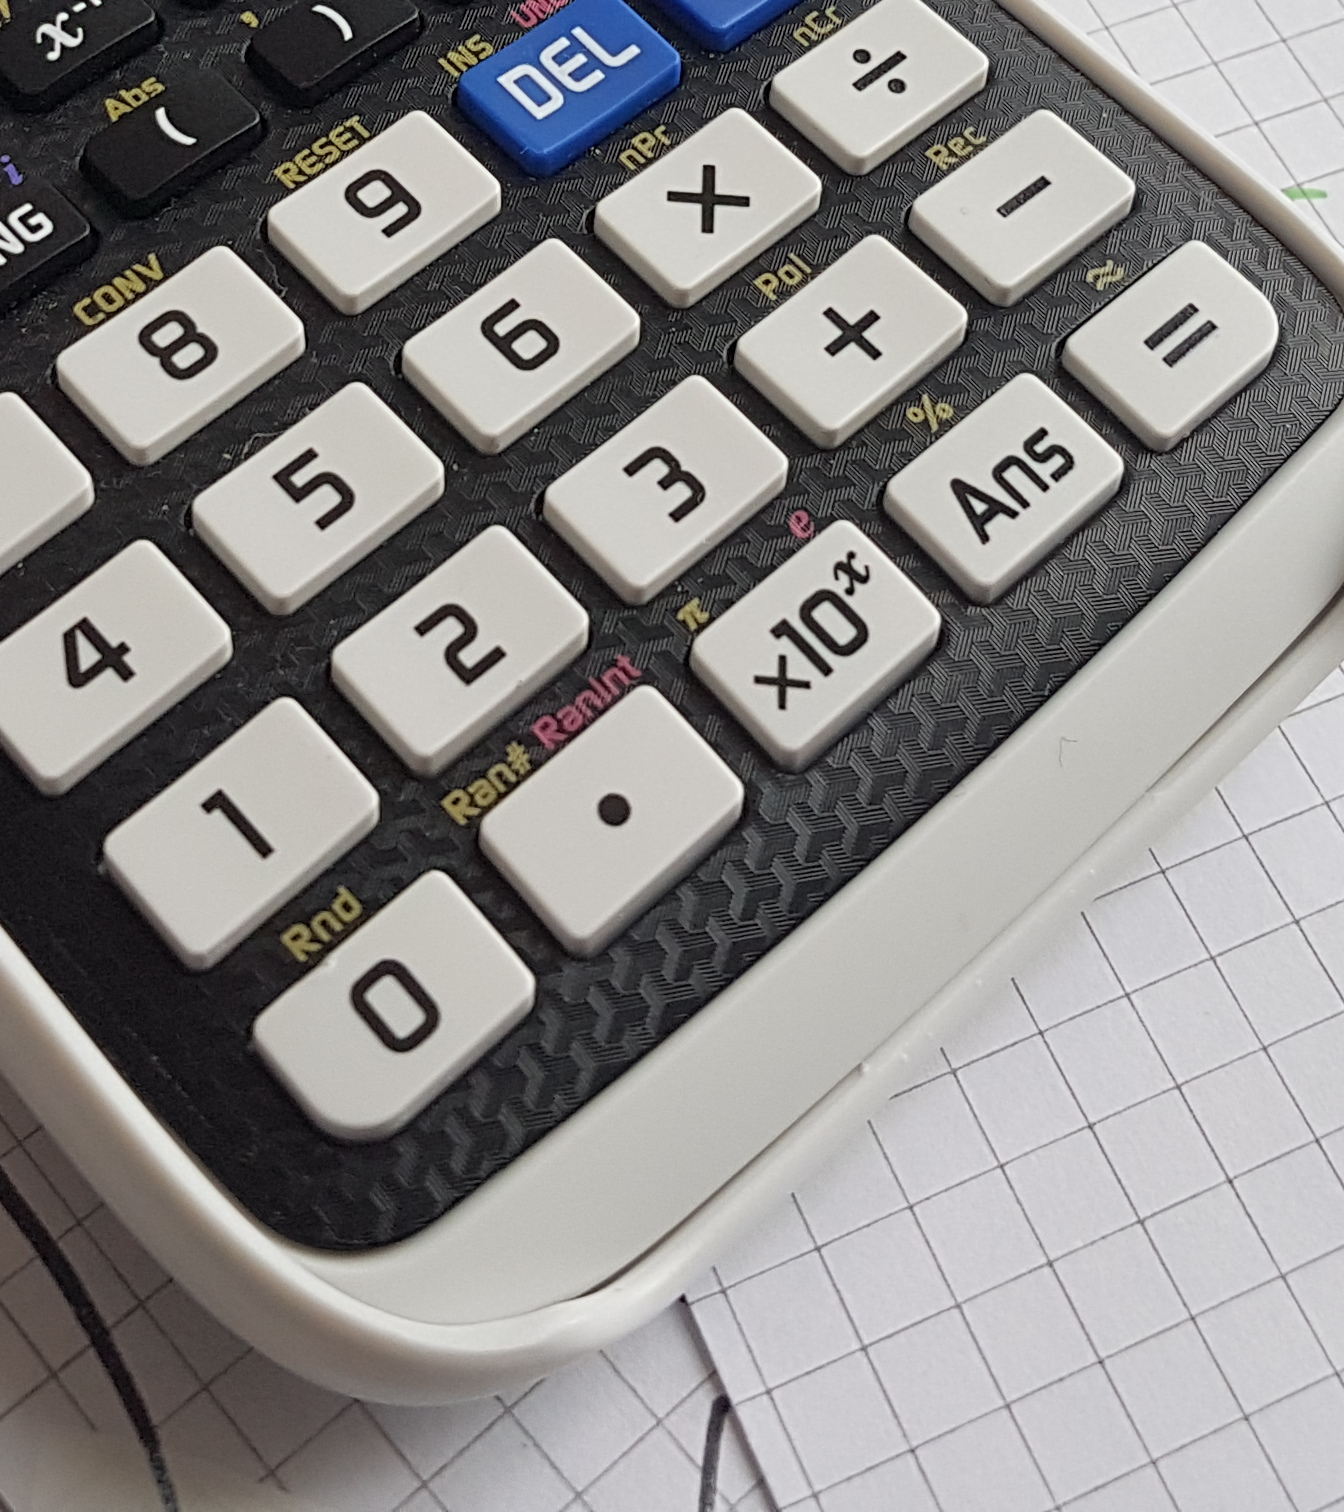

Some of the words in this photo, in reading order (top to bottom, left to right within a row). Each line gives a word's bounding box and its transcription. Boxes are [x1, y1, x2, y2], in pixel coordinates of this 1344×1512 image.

[439, 33, 496, 78] INS
[495, 25, 642, 122] DEL
[102, 75, 167, 123] Abs
[273, 114, 373, 189] RESET
[923, 125, 989, 171] Rec
[342, 167, 424, 240] 9
[71, 253, 166, 329] CONV
[752, 253, 813, 301] Pol
[138, 309, 219, 380] 8
[480, 297, 561, 372] 6
[821, 305, 883, 362] +
[1144, 301, 1219, 370] =
[907, 393, 954, 433] %
[271, 446, 357, 532] 5
[623, 444, 707, 524] 3
[948, 426, 1076, 546] Ans
[62, 616, 136, 689] 4
[413, 602, 508, 686] 2
[441, 741, 533, 826] Ran#
[531, 653, 644, 750] RanInt
[200, 789, 276, 860] 1
[279, 886, 366, 964] Rnd
[350, 958, 442, 1054] 0
